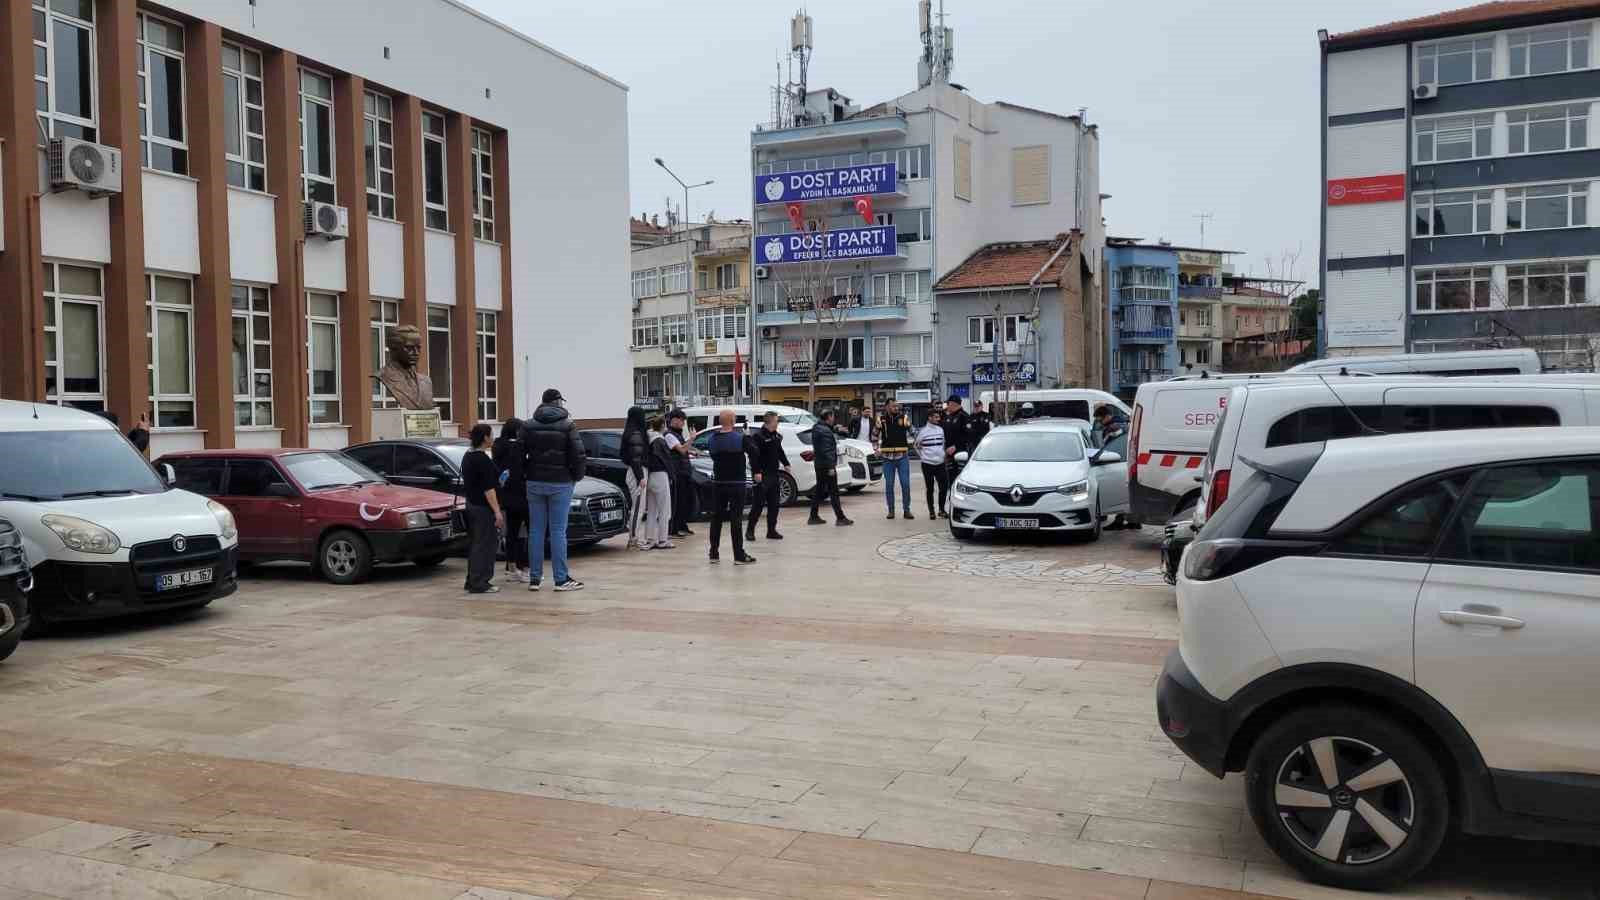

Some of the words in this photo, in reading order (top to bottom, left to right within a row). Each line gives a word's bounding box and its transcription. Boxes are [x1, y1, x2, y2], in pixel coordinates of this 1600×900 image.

[791, 172, 834, 190] DOST
[800, 190, 823, 199] AYDIN
[790, 233, 834, 250] DOST
